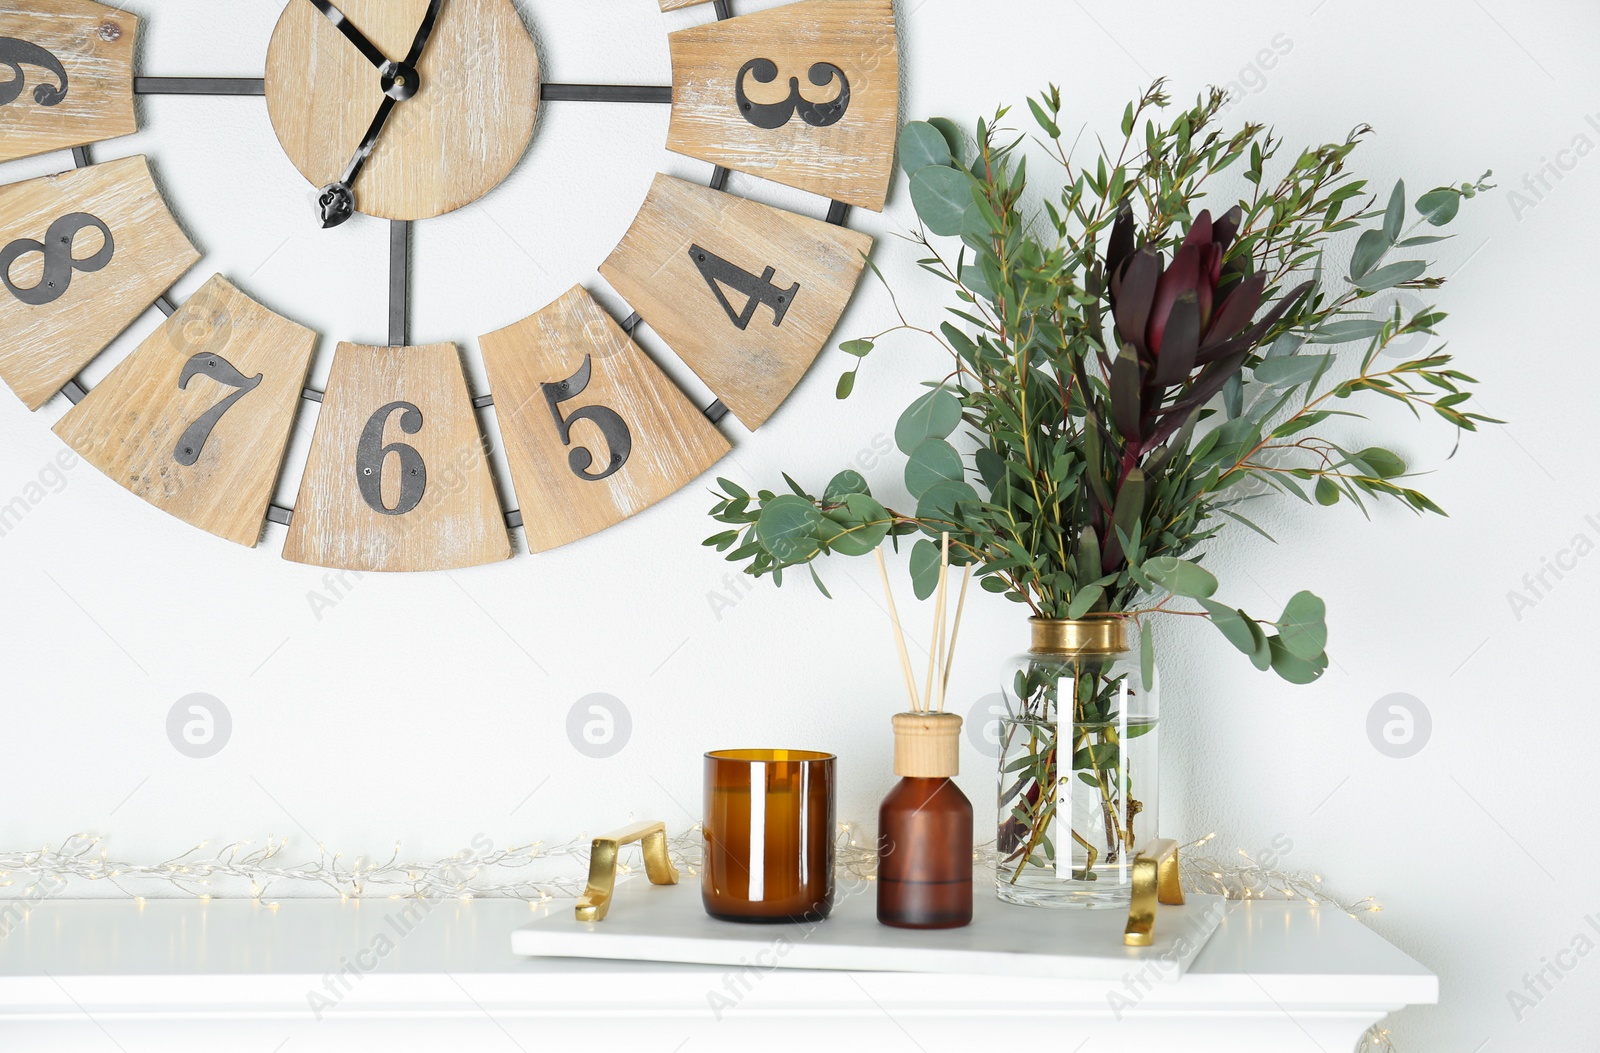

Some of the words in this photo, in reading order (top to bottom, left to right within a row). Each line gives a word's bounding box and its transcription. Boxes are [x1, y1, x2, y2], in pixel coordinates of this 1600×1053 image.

[735, 58, 850, 129] 3
[0, 212, 114, 305] 8
[688, 243, 800, 330] 4
[173, 351, 263, 466] 7
[356, 401, 426, 515] 6
[541, 353, 632, 481] 5
